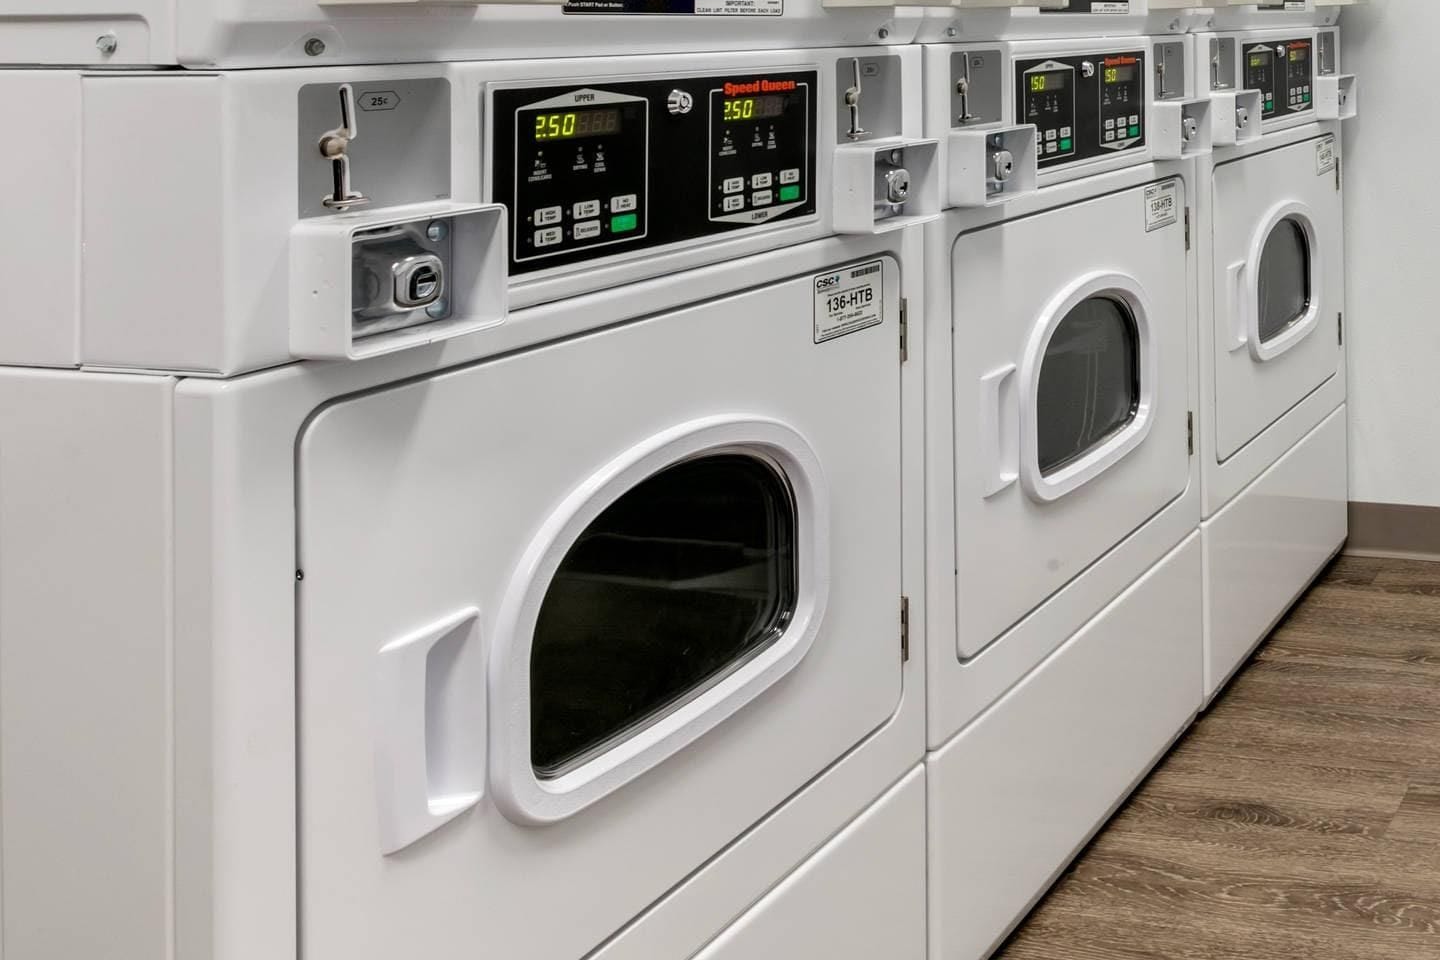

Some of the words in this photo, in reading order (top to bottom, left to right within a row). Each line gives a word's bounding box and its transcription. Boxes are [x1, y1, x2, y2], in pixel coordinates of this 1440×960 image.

[723, 81, 759, 95] Speed
[762, 79, 796, 91] Queen
[574, 93, 595, 103] UPPER
[752, 211, 768, 220] LOWER
[816, 277, 834, 288] CSC
[827, 287, 872, 312] 136-HTB
